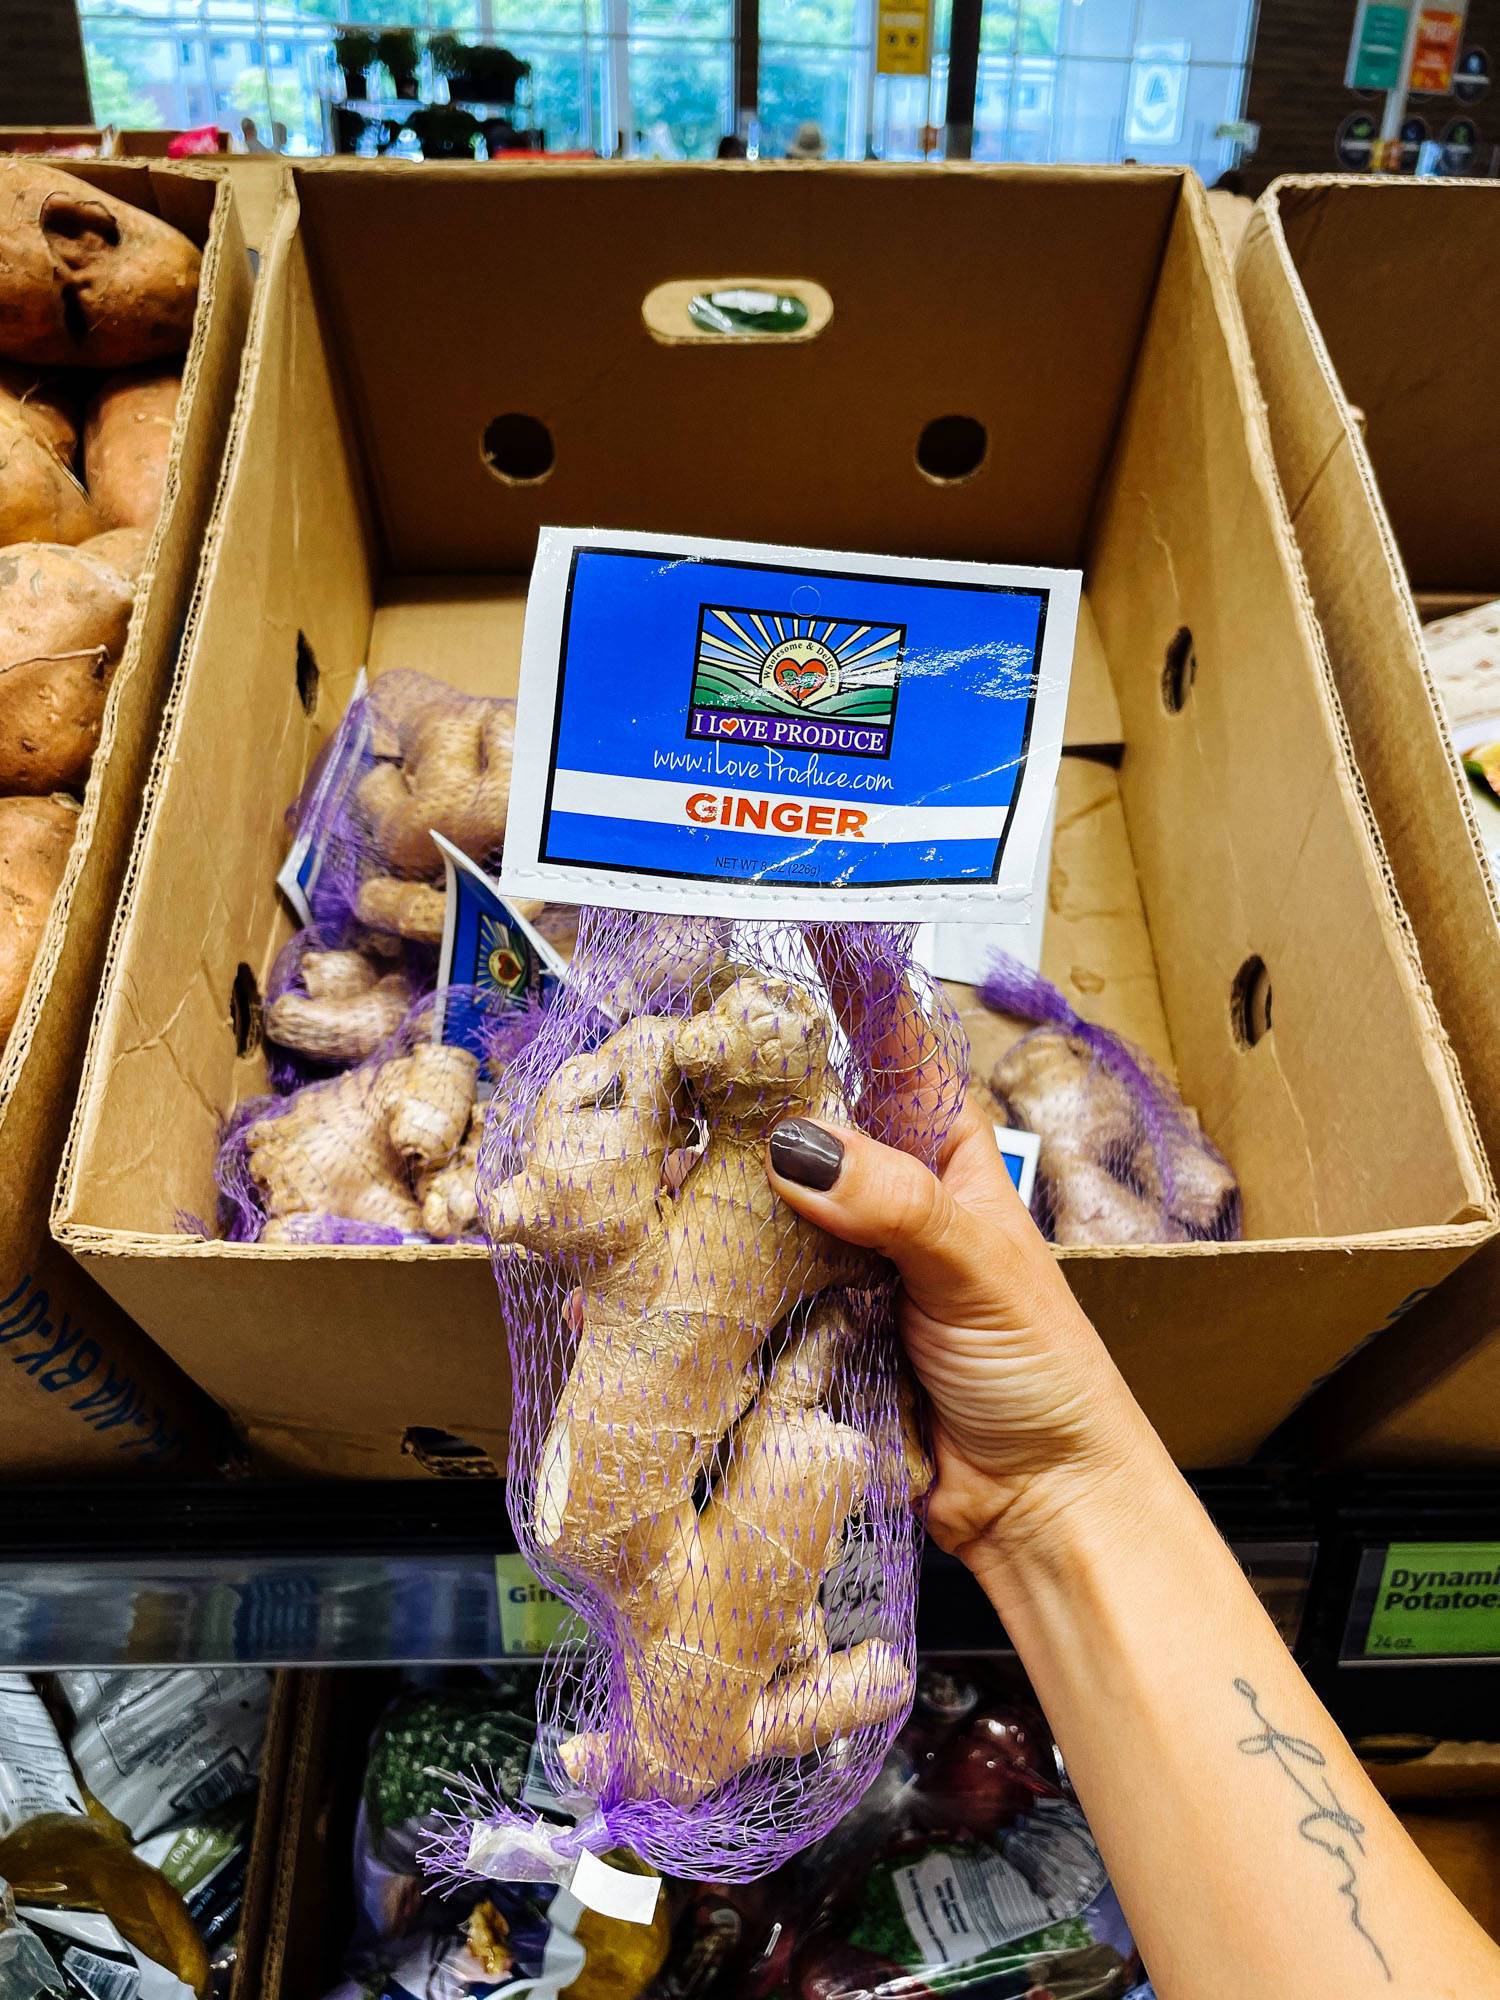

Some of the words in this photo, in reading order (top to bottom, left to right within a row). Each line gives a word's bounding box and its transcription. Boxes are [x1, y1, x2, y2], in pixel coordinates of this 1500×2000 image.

[763, 643, 803, 679] Wholesome
[806, 642, 814, 651] &
[693, 714, 703, 733] I
[774, 723, 884, 751] PRODUCE
[685, 792, 869, 838] GINGER
[715, 856, 738, 869] NET
[741, 859, 758, 871] WT
[788, 863, 821, 877] (226g)
[1384, 1591, 1500, 1612] Potatoe
